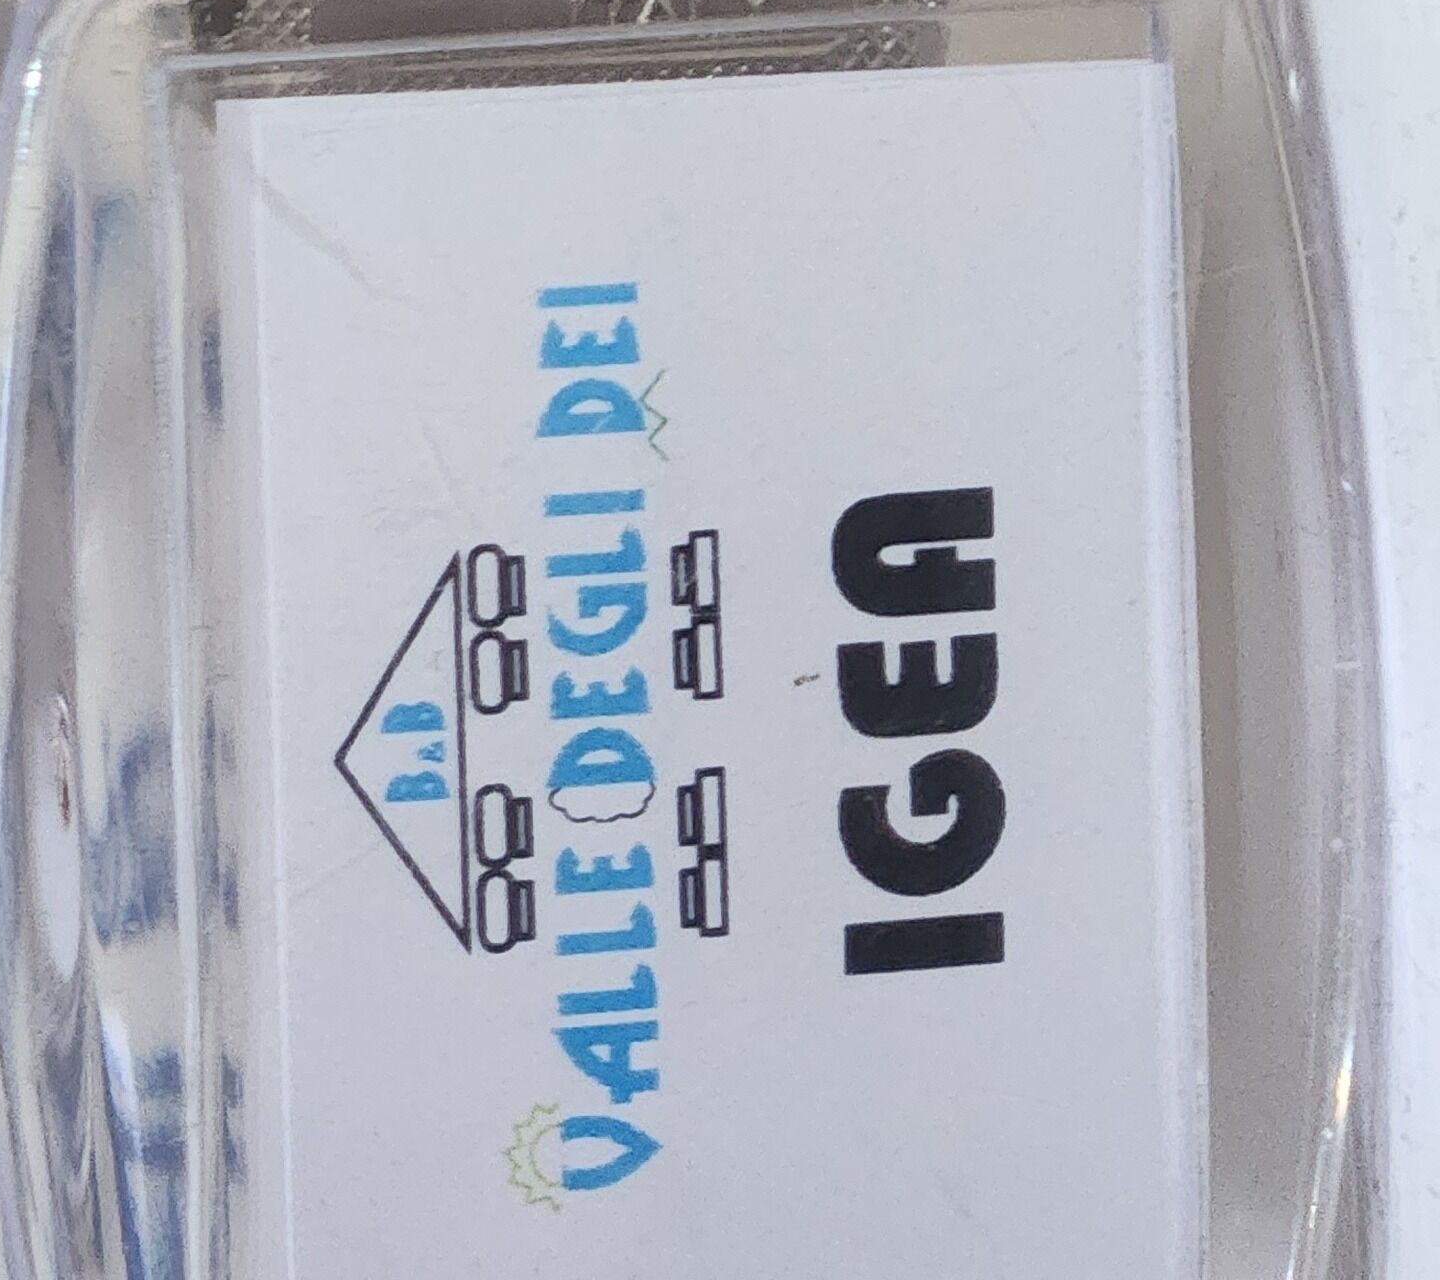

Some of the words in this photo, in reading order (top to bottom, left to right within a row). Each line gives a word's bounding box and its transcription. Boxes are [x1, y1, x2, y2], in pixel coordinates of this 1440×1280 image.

[536, 280, 647, 439] DEI
[381, 700, 451, 804] B&B
[544, 488, 656, 790] DEGLI
[831, 485, 1008, 977] IGEA
[553, 842, 663, 1193] VALLE
